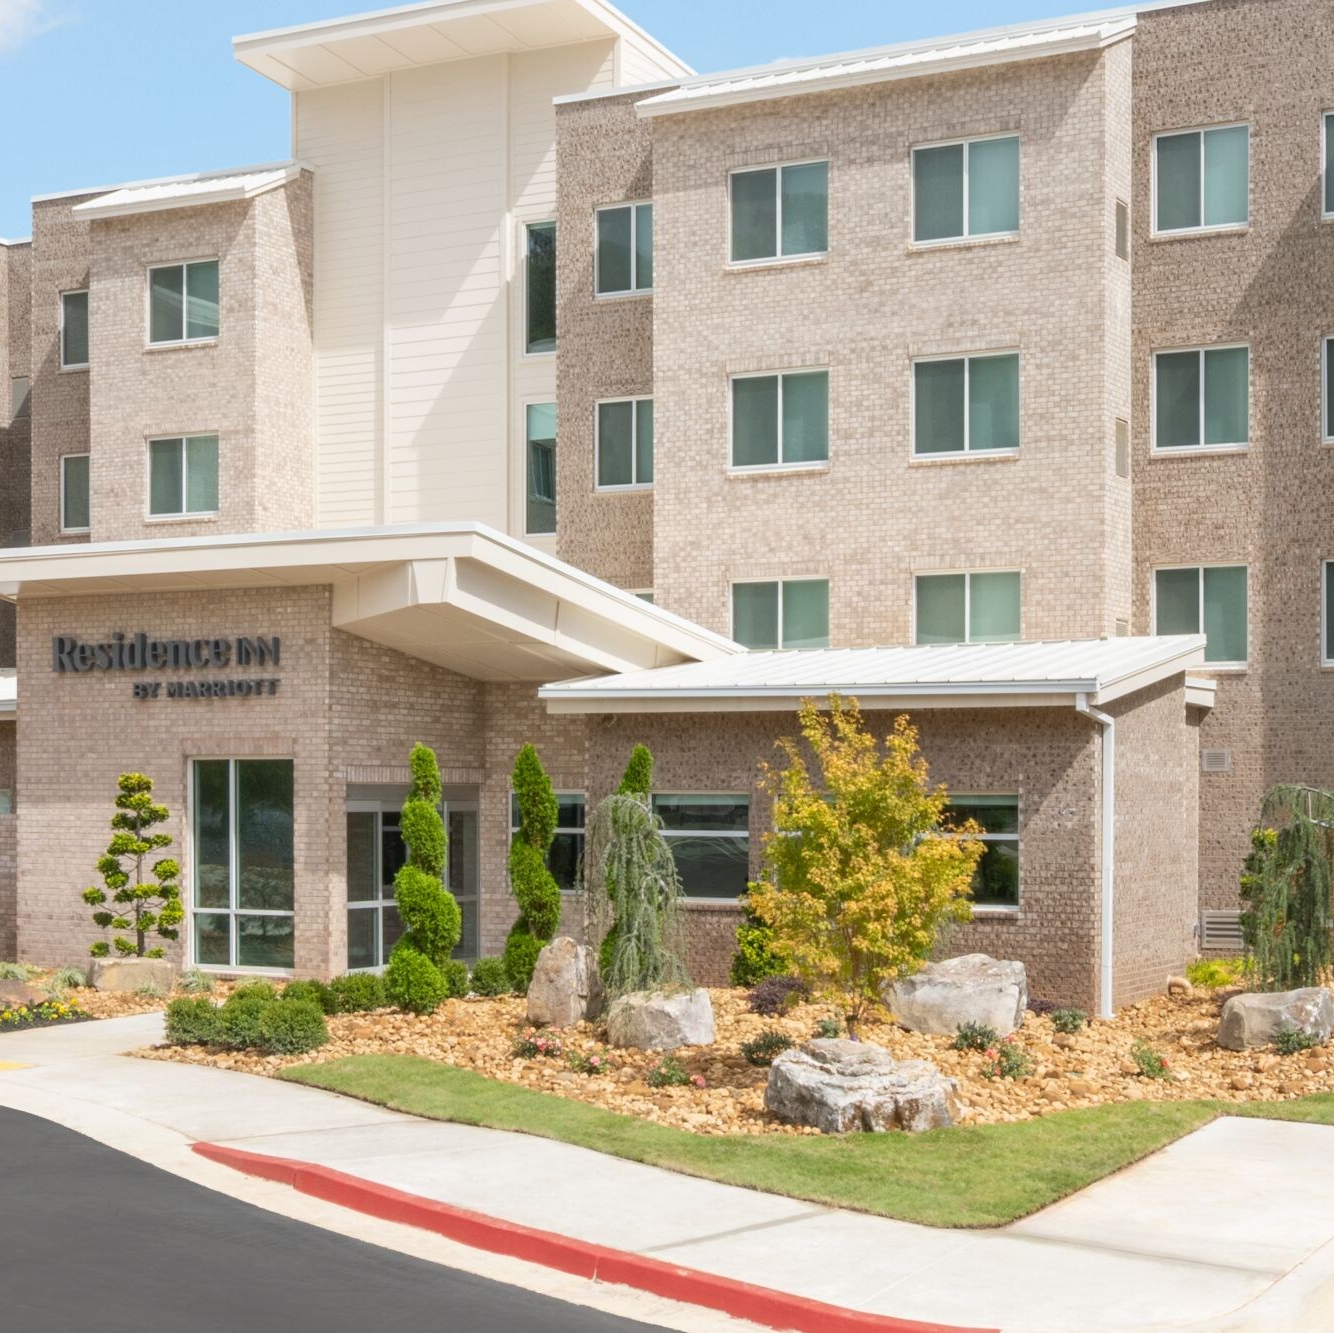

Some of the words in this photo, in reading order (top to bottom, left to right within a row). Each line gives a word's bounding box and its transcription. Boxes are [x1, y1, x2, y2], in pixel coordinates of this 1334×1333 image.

[52, 632, 230, 672] Residence
[235, 636, 280, 666] INN
[132, 681, 161, 698] BY
[167, 678, 280, 698] MARRIOTT
